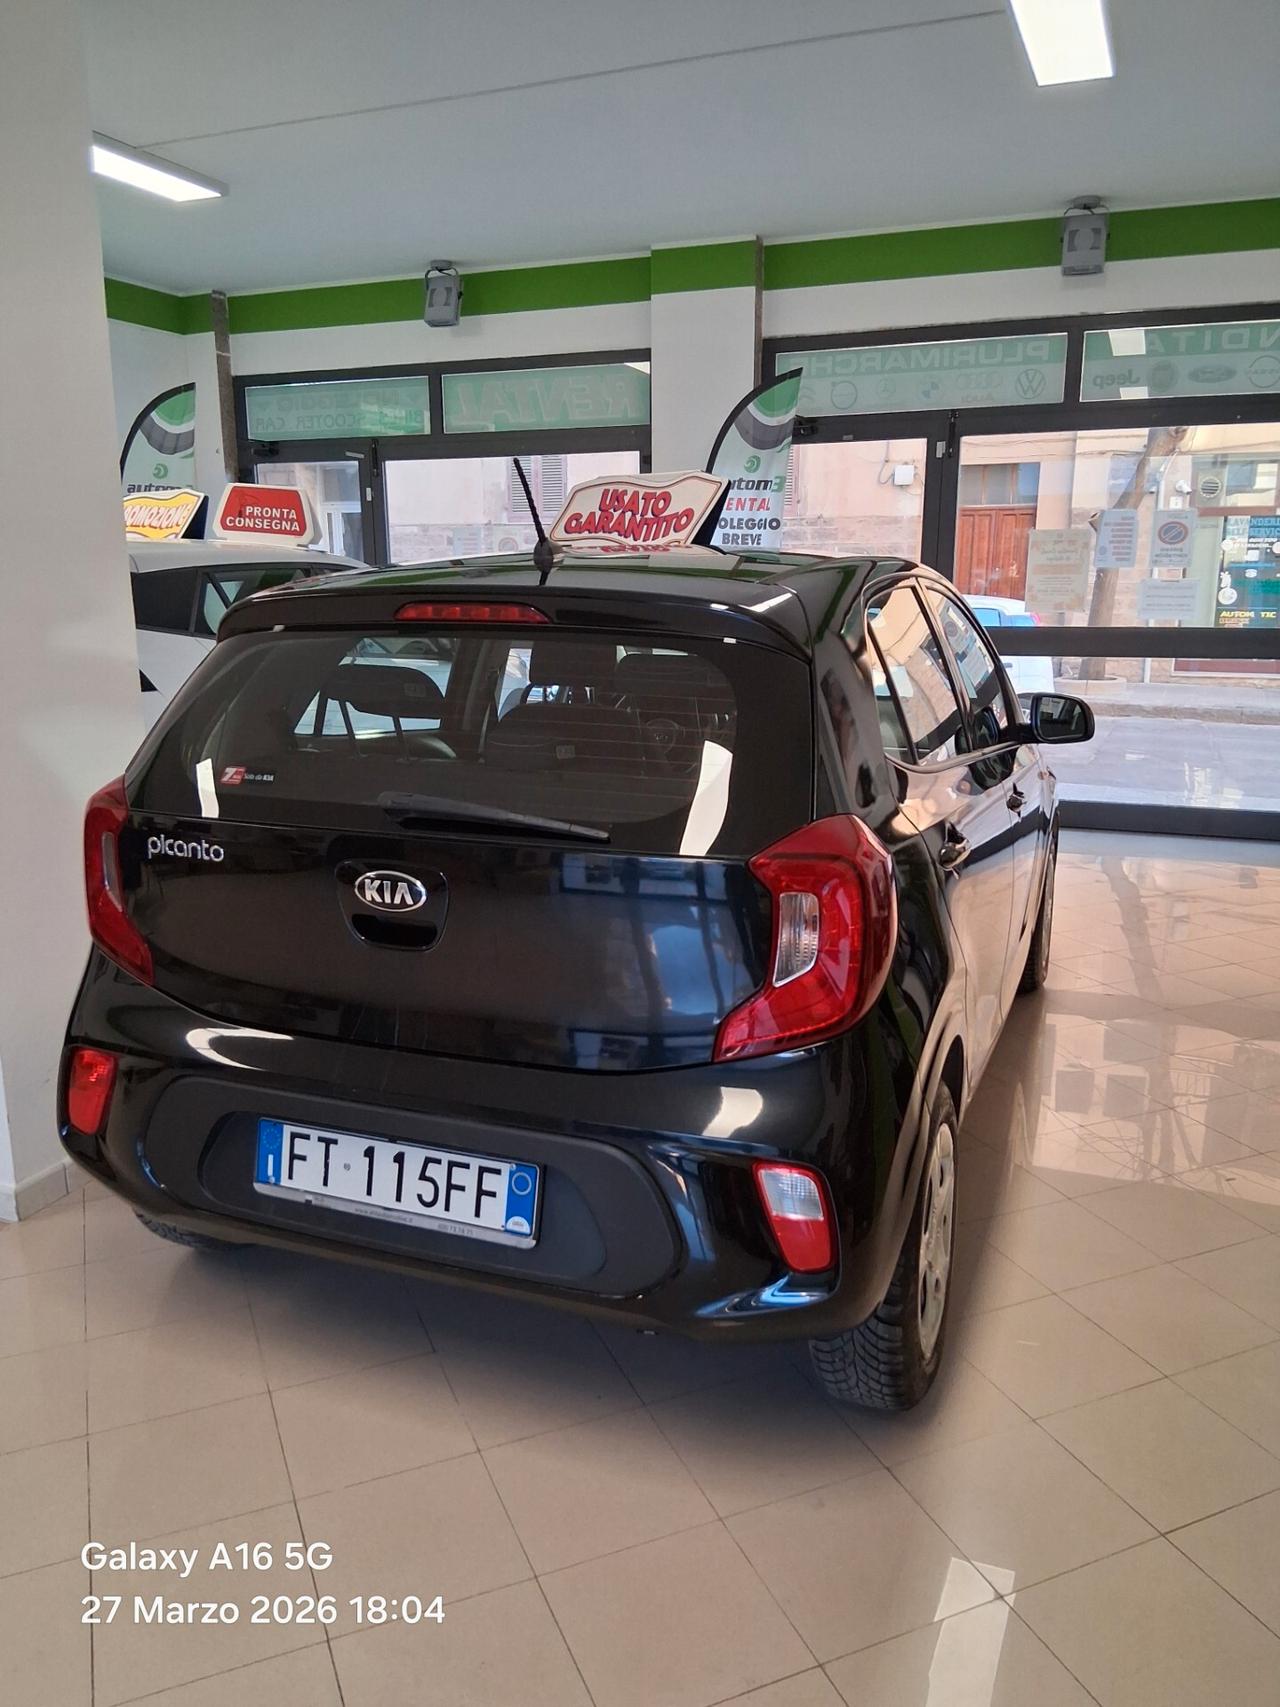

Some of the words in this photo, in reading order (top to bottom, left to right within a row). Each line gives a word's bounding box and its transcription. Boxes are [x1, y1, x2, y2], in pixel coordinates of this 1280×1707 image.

[599, 489, 672, 517] USATO
[726, 497, 771, 512] ENTAL
[246, 506, 297, 519] PRONTA
[226, 517, 300, 531] CONSEGNA
[564, 508, 695, 542] GARANTITO
[718, 518, 781, 532] OLEGGIO
[722, 533, 762, 546] BREVE
[147, 834, 224, 862] picanto
[364, 878, 414, 905] KIA
